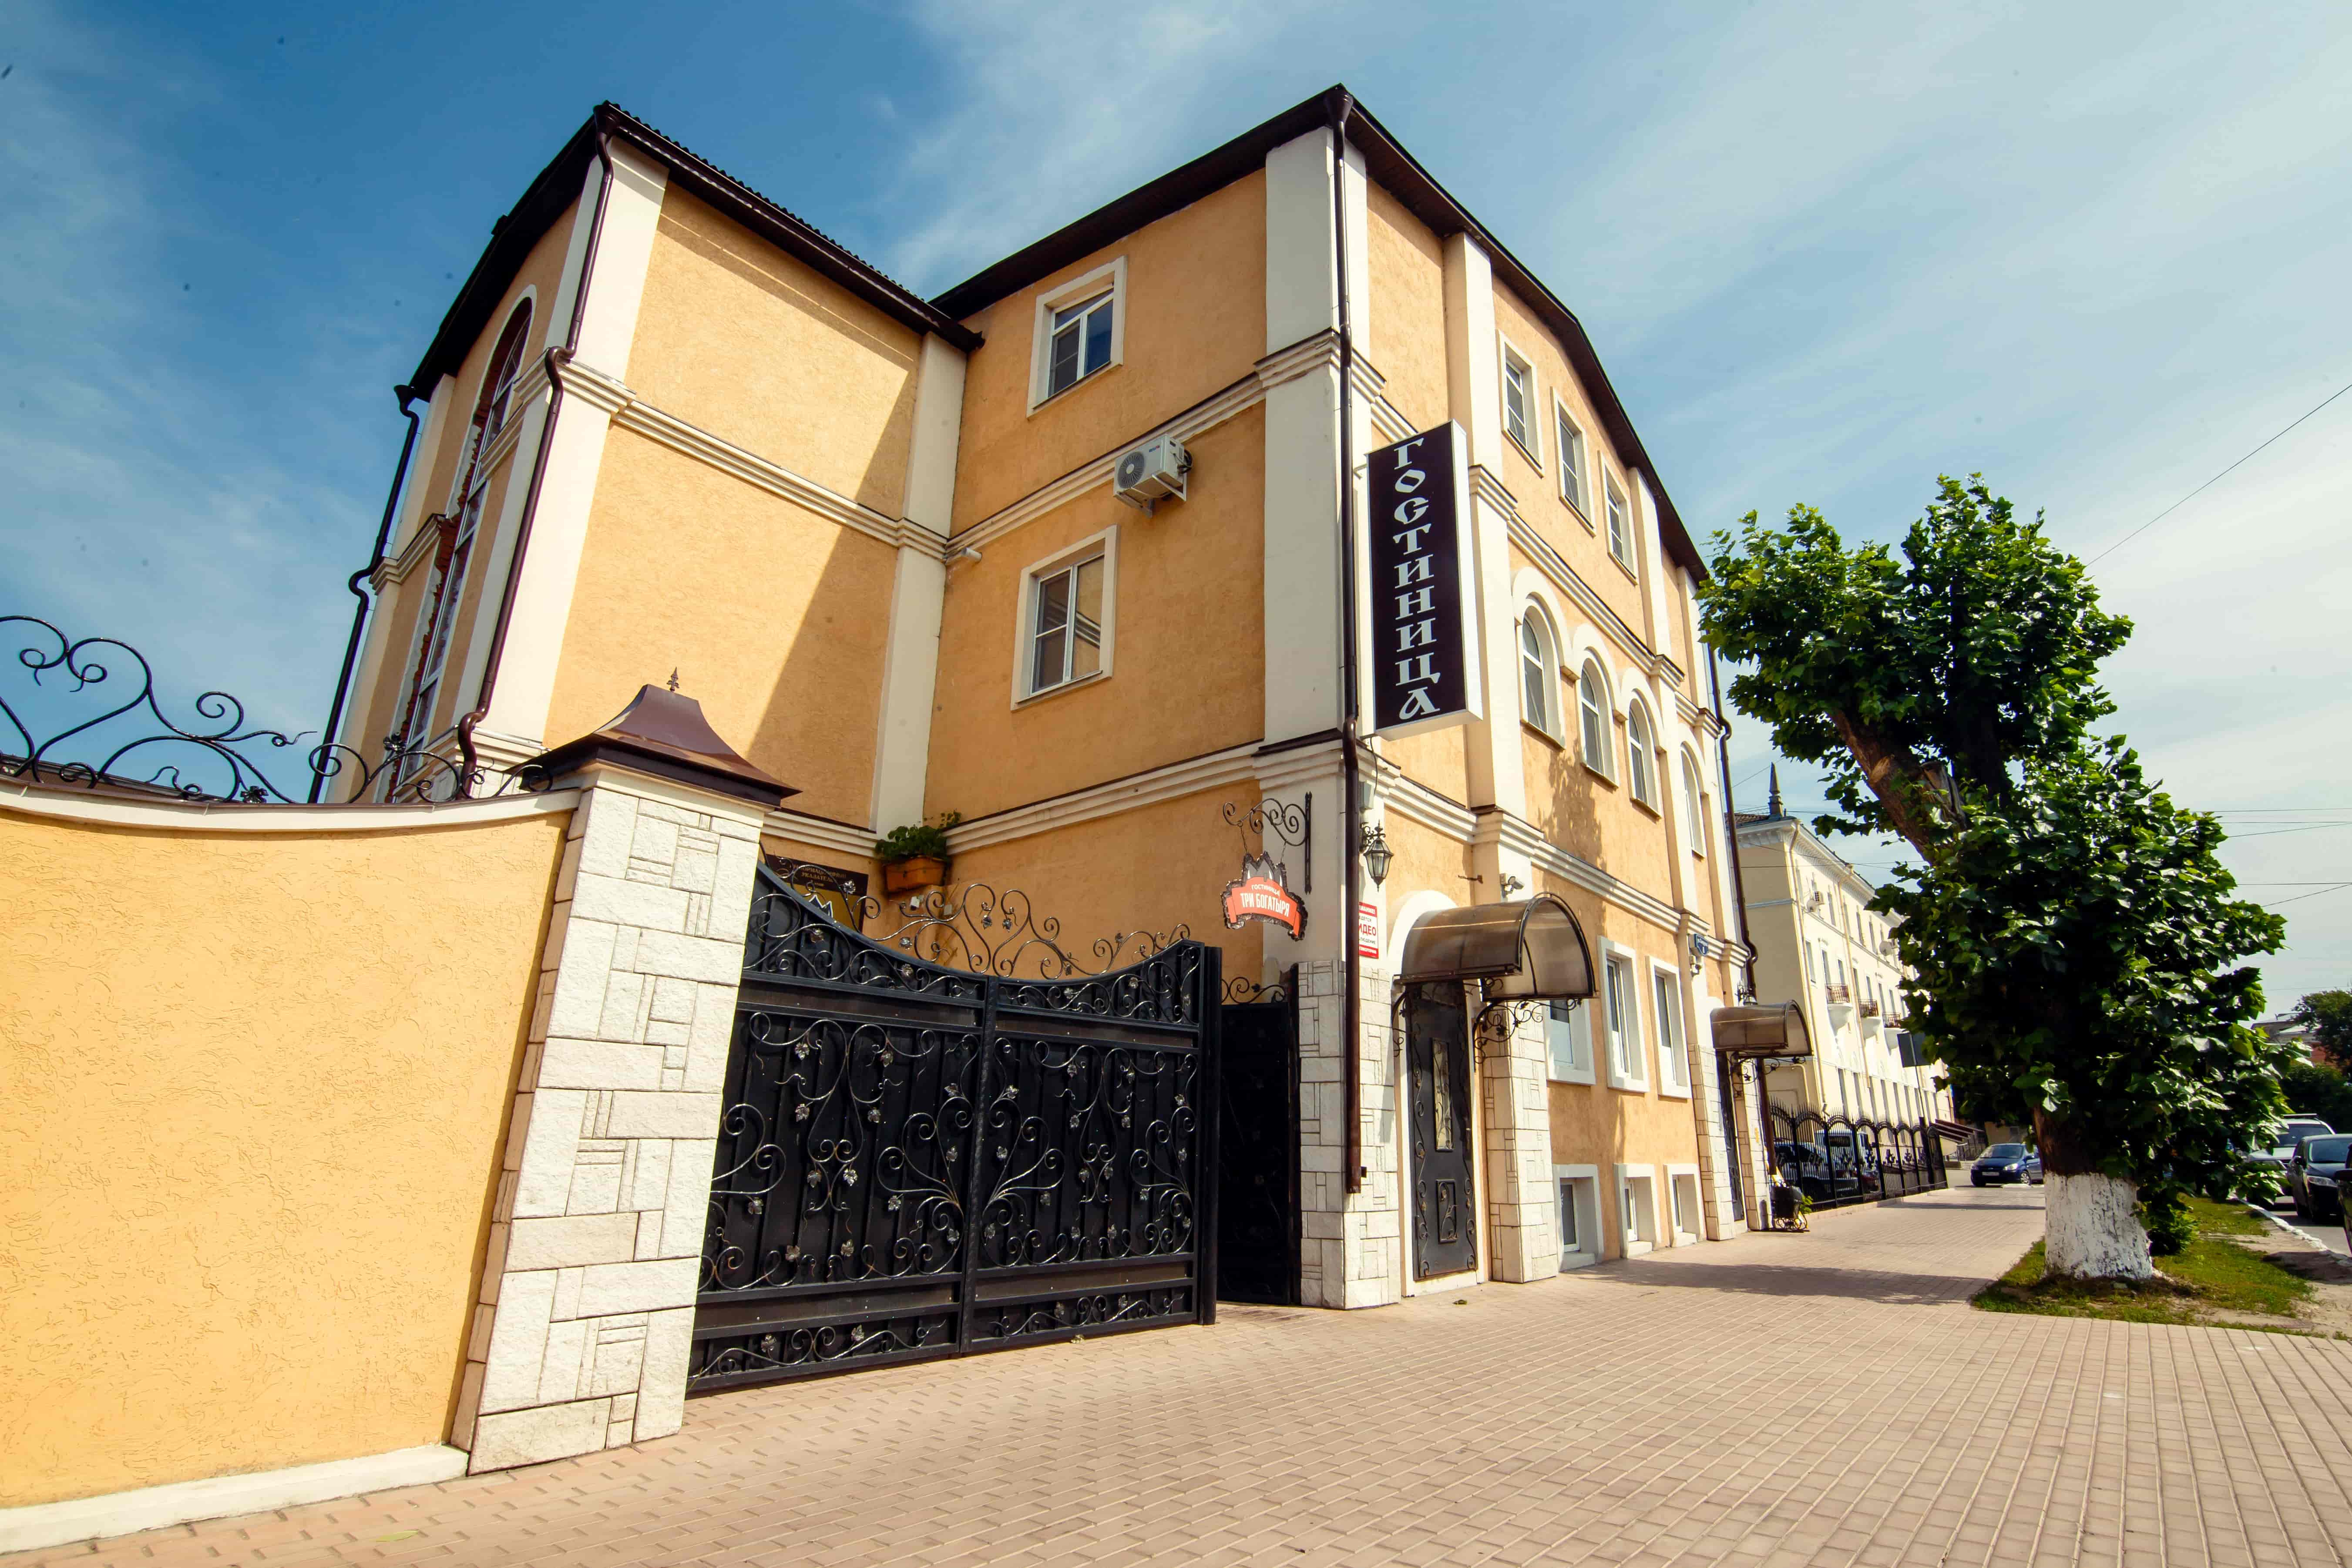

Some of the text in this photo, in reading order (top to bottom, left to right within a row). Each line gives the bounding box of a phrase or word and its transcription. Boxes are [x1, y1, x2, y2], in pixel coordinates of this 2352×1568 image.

[1393, 438, 1441, 720] ГОСТИНИЦА
[1240, 893, 1290, 917] ТРИ БОГАТЫРЯ
[1358, 923, 1376, 936] ИДЕО
